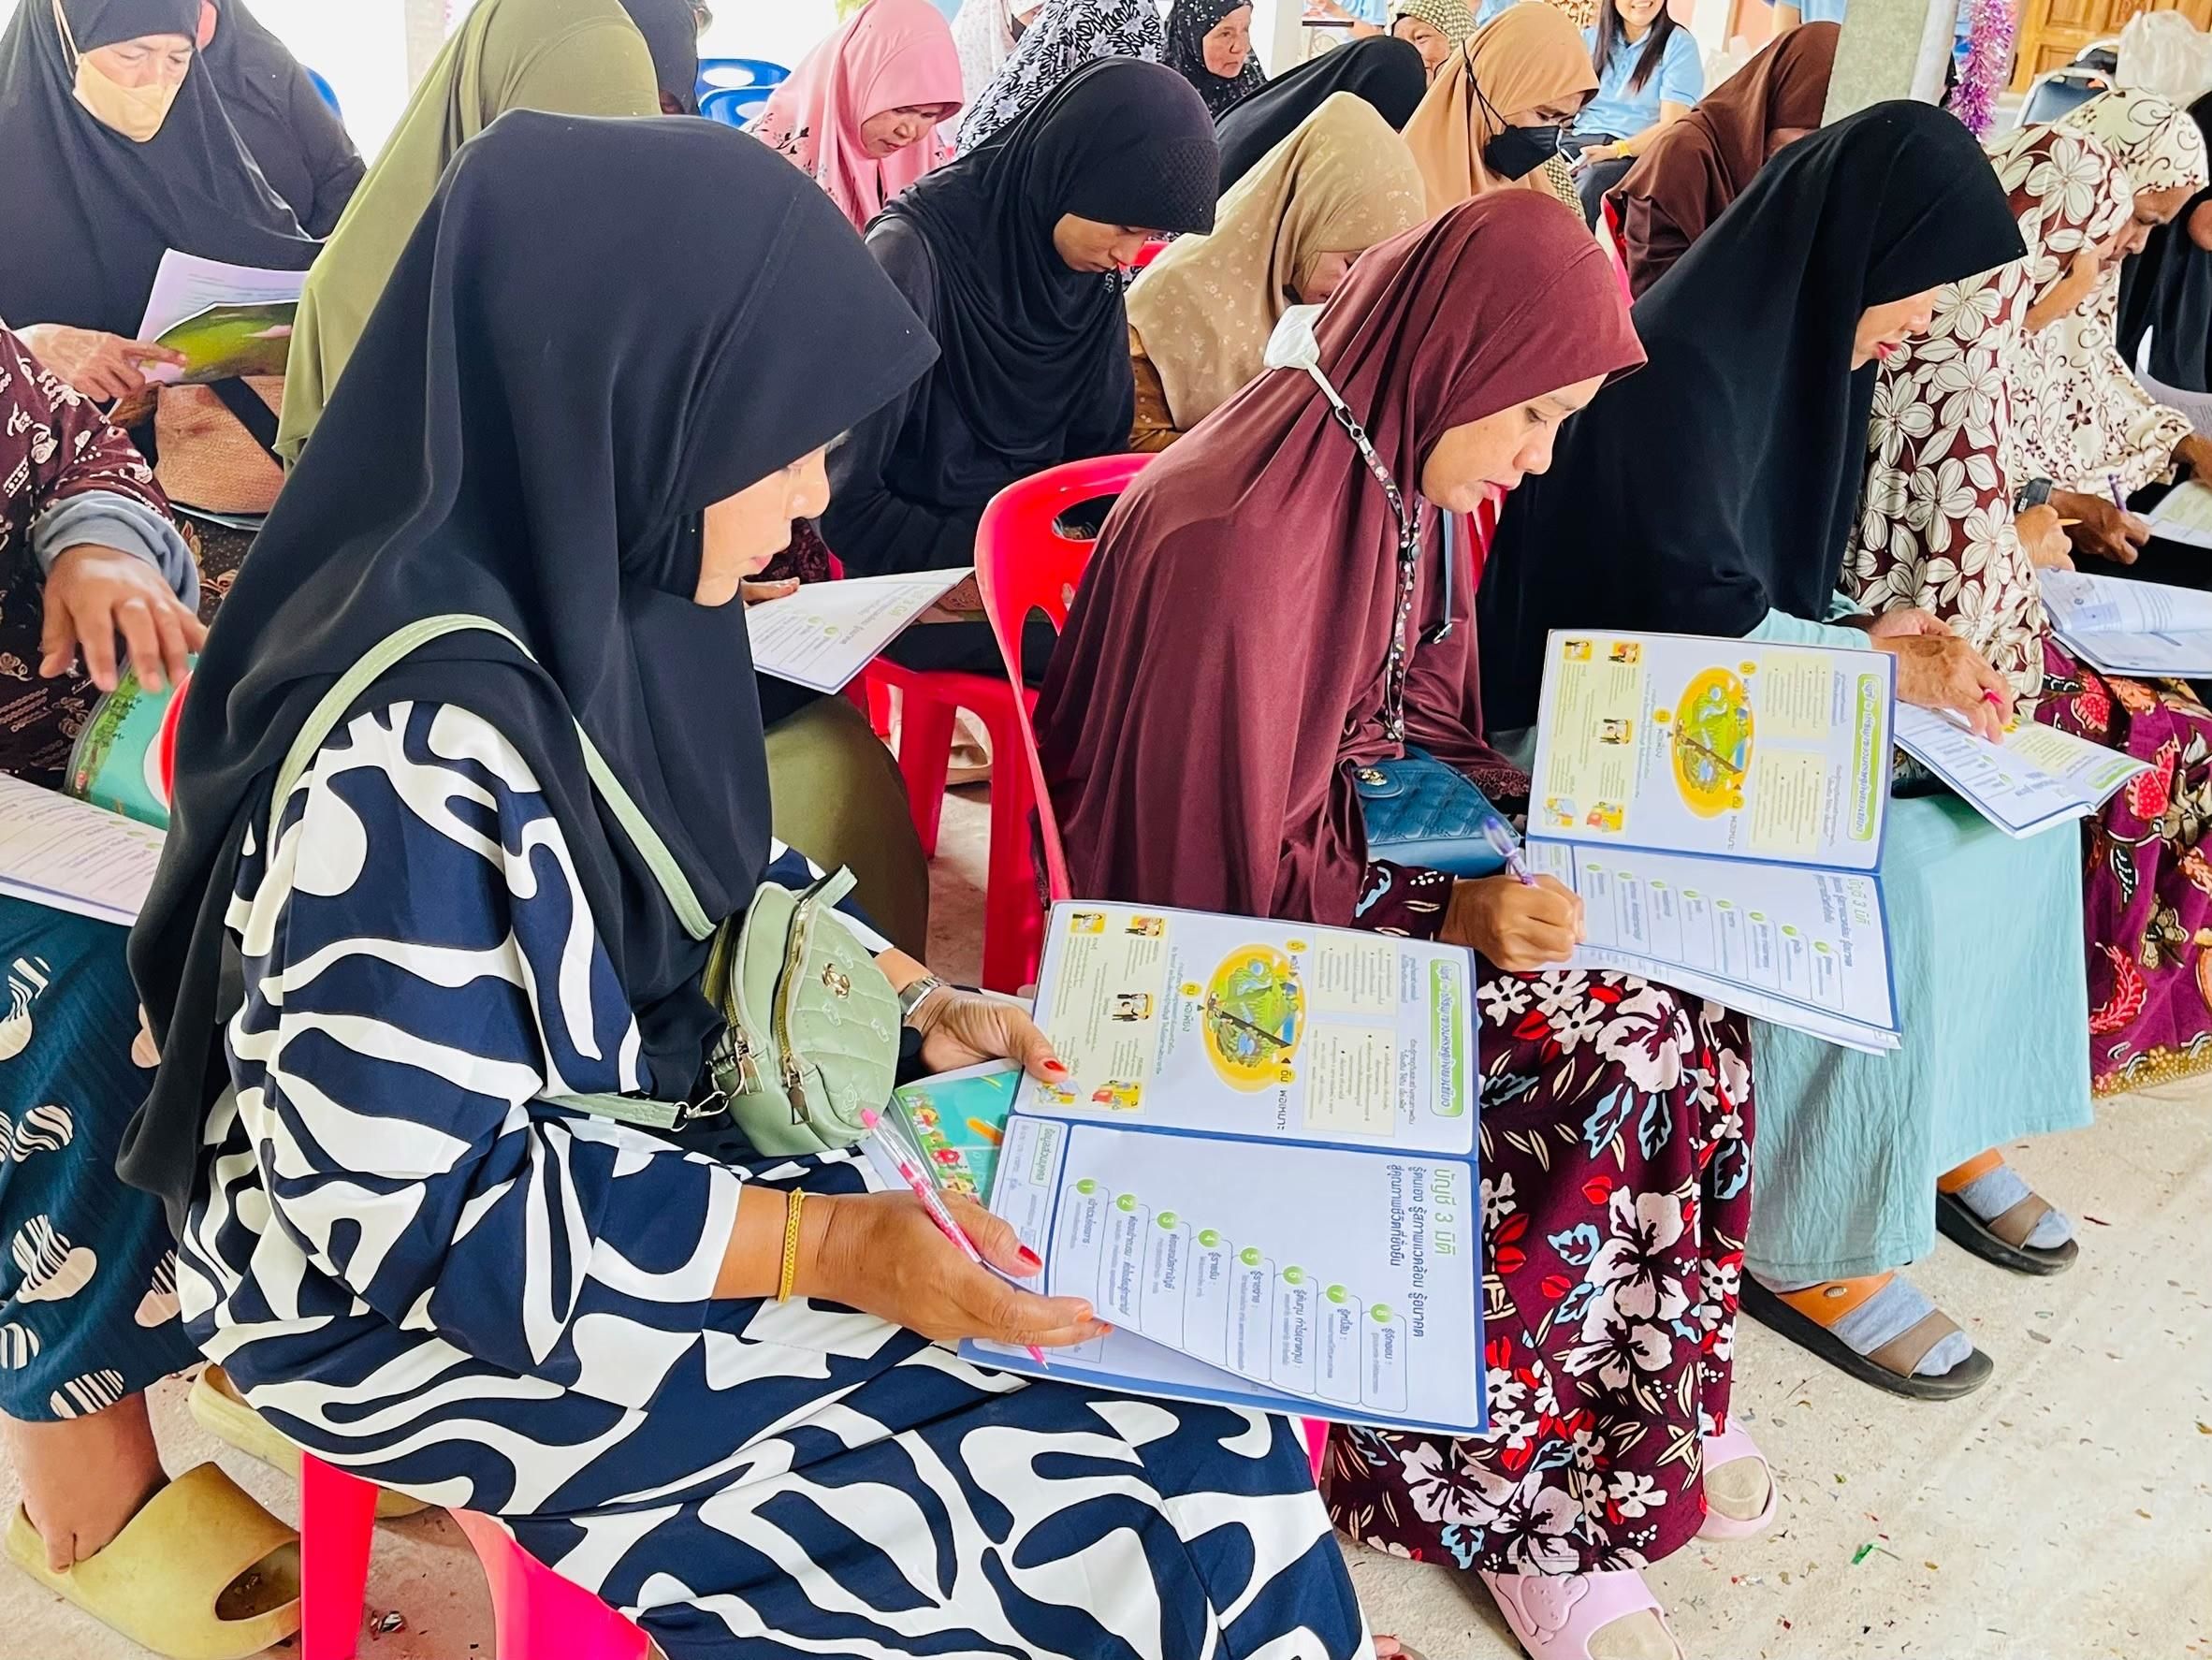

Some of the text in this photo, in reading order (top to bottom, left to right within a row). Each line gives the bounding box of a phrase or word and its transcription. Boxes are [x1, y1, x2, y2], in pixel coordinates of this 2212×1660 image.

[1182, 984, 1197, 1032] คน พอเพียง
[1280, 1070, 1293, 1083] ดิน
[1276, 1089, 1288, 1130] พอเหมาะ
[1035, 1129, 1056, 1181] ข้อมูลส่วนบุคคล
[1386, 1164, 1406, 1267] สู่คุณภาพชีวิตที่ยั่งยืน
[1431, 1168, 1456, 1255] บัญชี 3 มิติ
[1407, 1166, 1428, 1337] รู้ตนเอง รู้สภาพแวดล้อม รู้อนาคต
